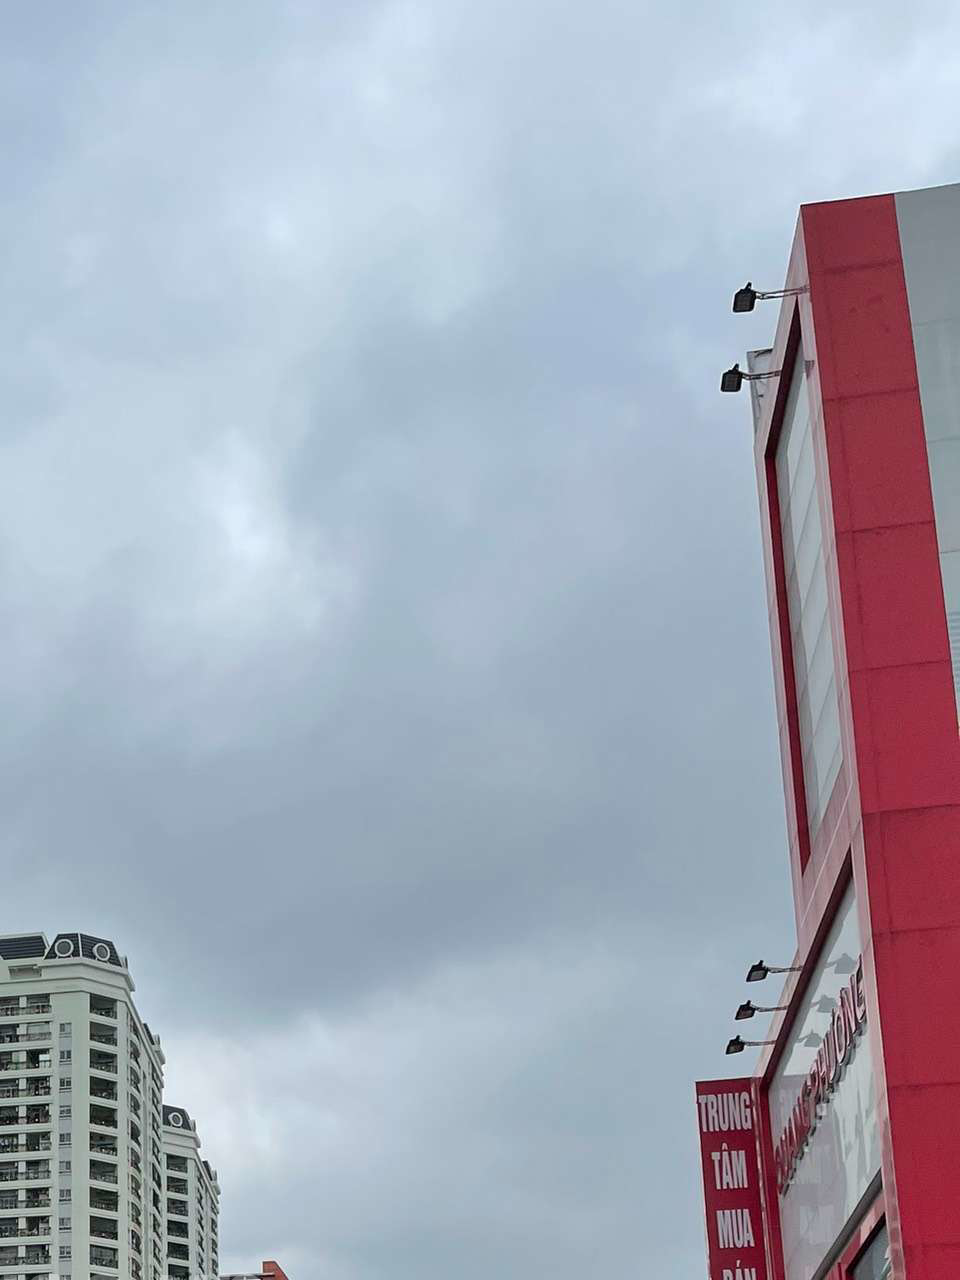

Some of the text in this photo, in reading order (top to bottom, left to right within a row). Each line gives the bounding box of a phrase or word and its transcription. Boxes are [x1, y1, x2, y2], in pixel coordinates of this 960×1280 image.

[698, 1091, 752, 1132] TRUNG
[711, 1142, 749, 1189] TÂM
[716, 1208, 755, 1249] MUA
